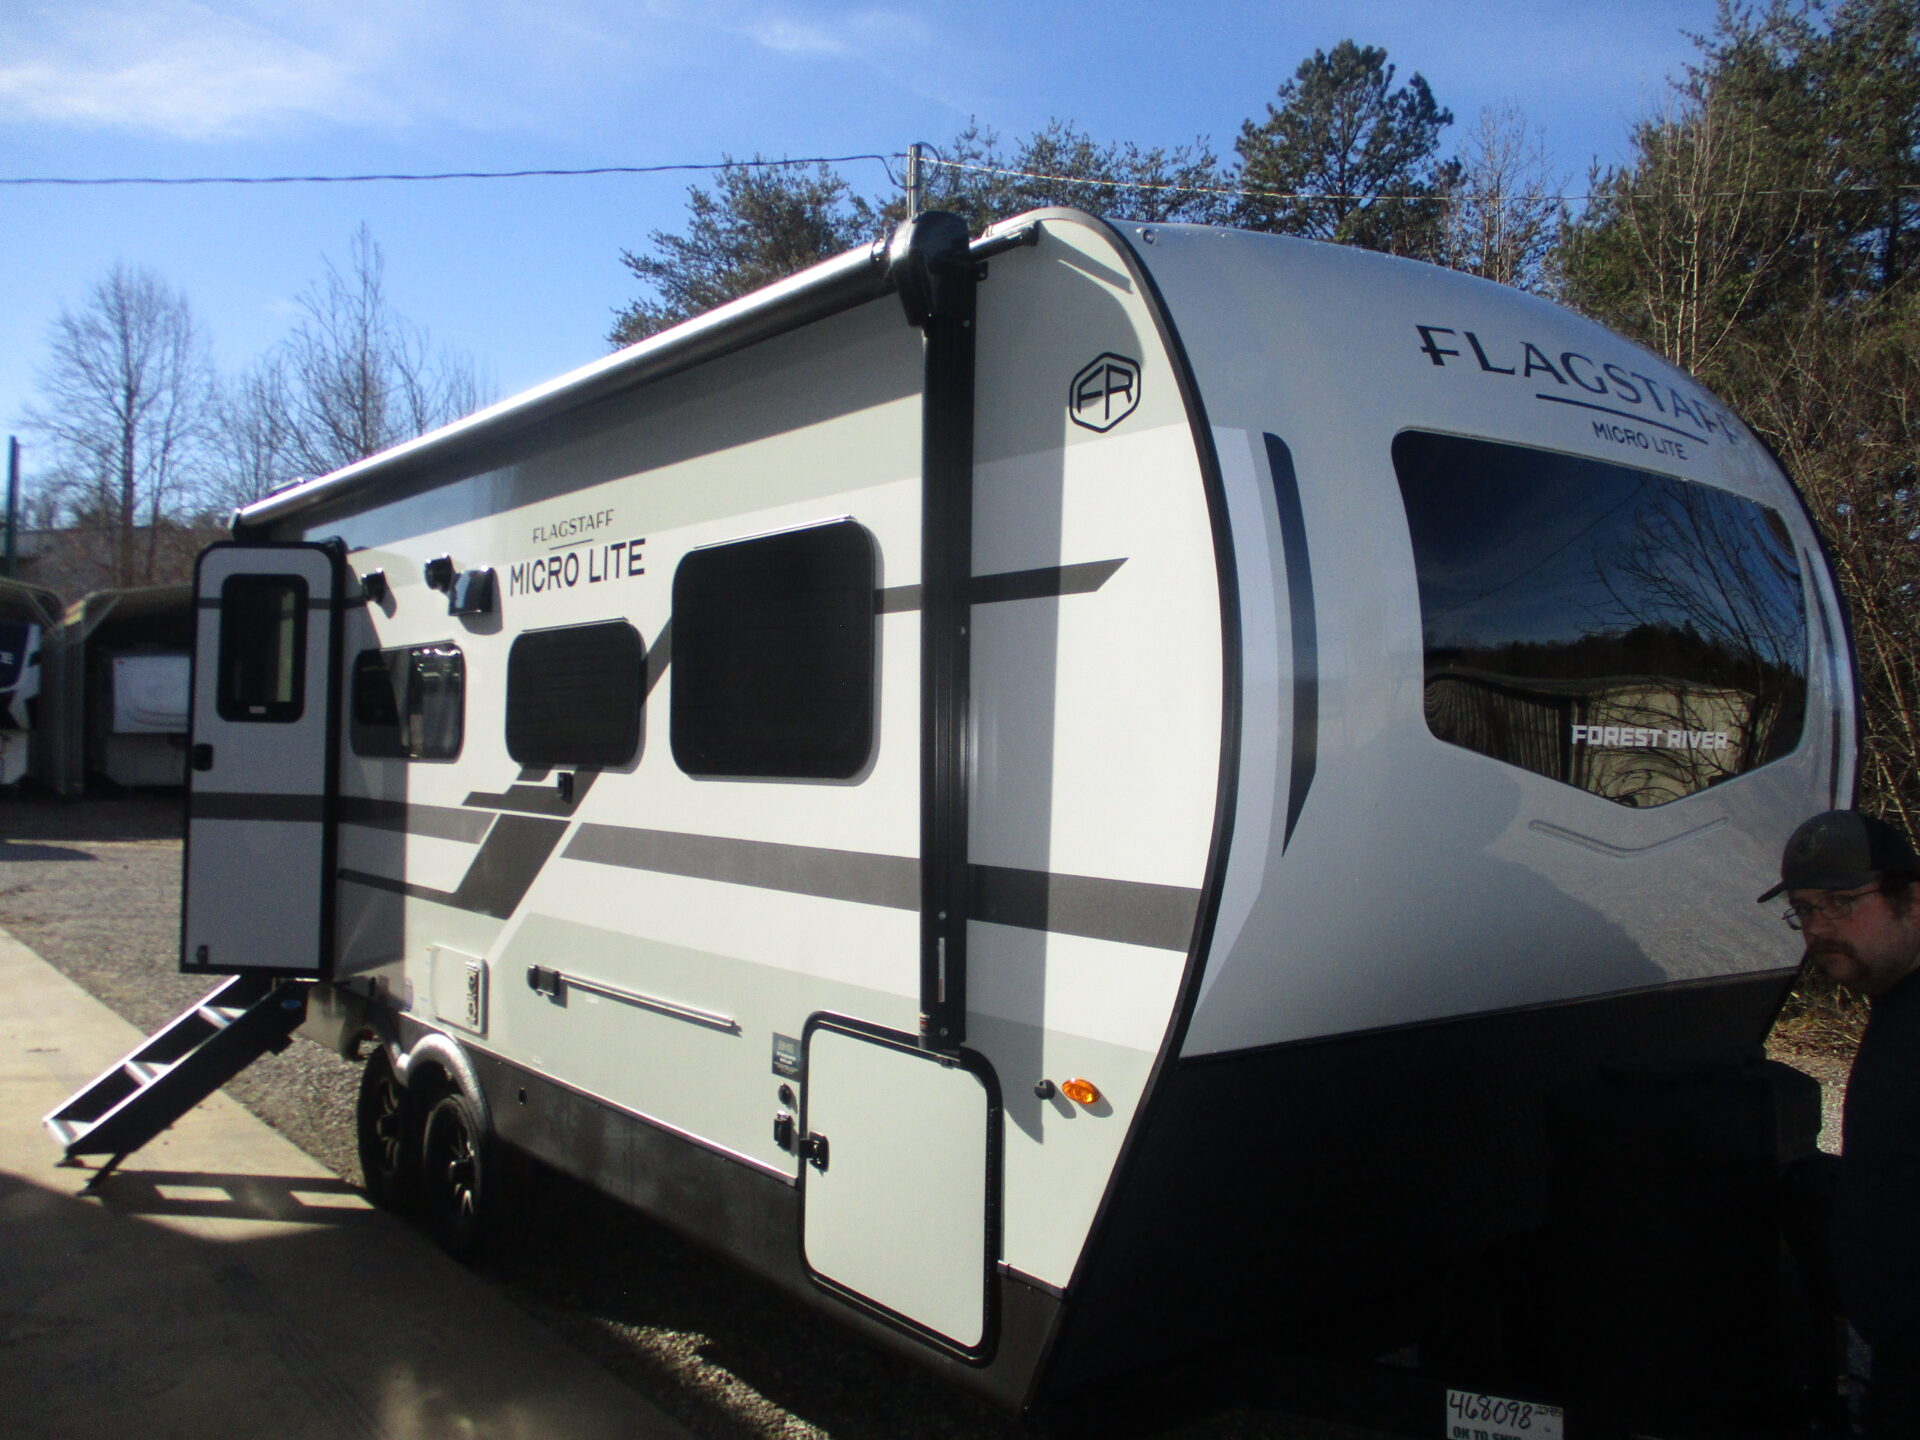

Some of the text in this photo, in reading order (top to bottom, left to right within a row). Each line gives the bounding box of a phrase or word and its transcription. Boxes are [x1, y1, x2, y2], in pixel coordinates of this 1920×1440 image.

[1415, 324, 1739, 445] FLAGSTAFF
[1592, 421, 1688, 460] MICRO LITE
[532, 508, 615, 544] FLAGSTAFF
[510, 538, 646, 597] MICRO LITE
[1571, 724, 1729, 750] FOREST RIVER
[1449, 1393, 1533, 1430] 468098
[1453, 1426, 1470, 1439] OK
[1473, 1430, 1489, 1440] TO
